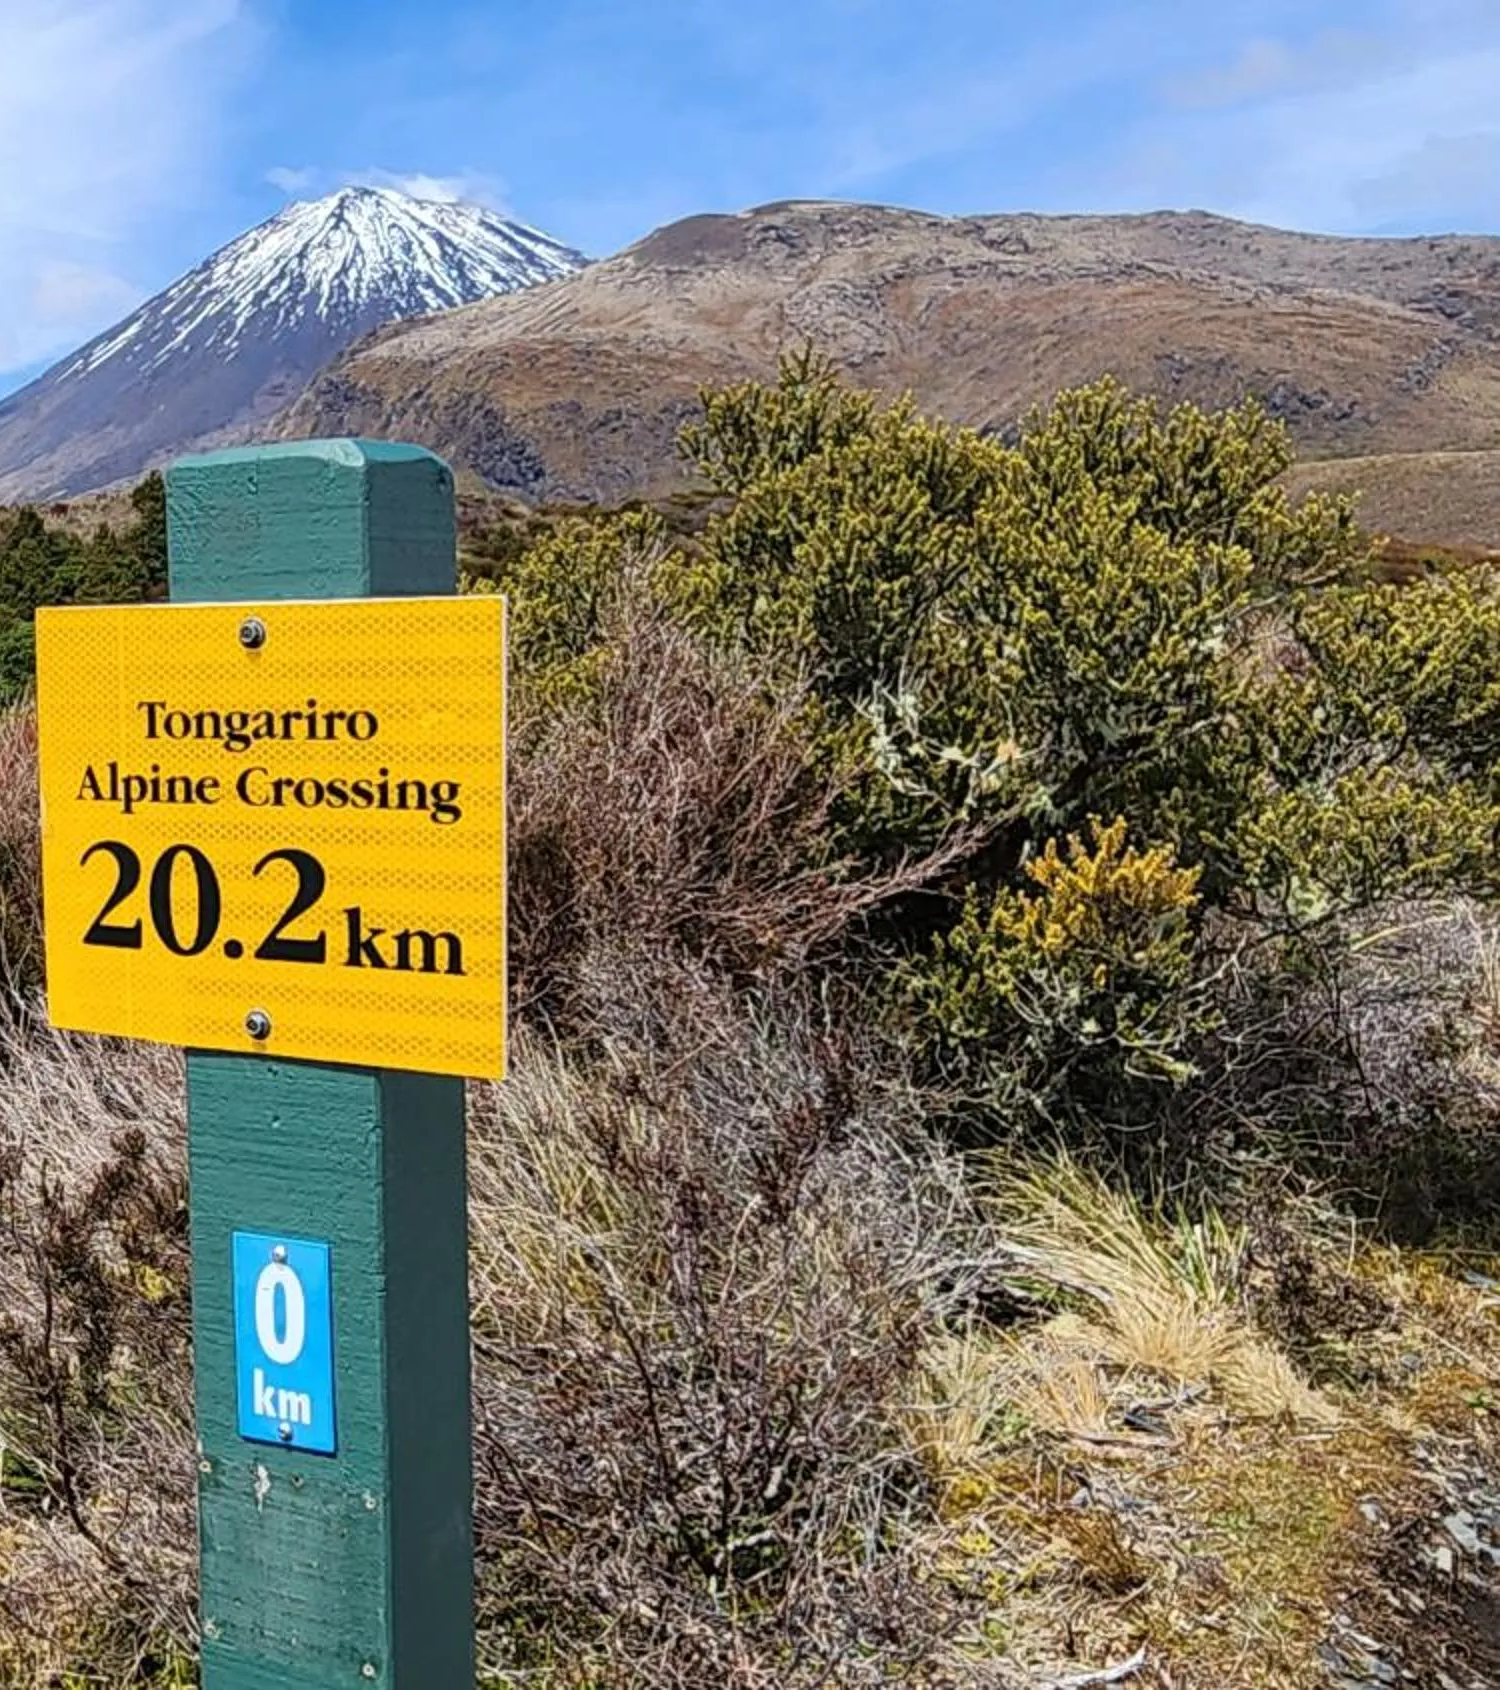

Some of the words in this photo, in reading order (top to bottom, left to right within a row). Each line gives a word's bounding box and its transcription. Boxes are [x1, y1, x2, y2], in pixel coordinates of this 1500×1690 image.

[137, 698, 379, 752] Tongariro
[76, 761, 221, 814] Alpine
[236, 766, 463, 824] Crossing
[79, 839, 327, 965] 20.2
[342, 907, 467, 976] km
[255, 1262, 306, 1365] 0
[252, 1368, 312, 1425] km
